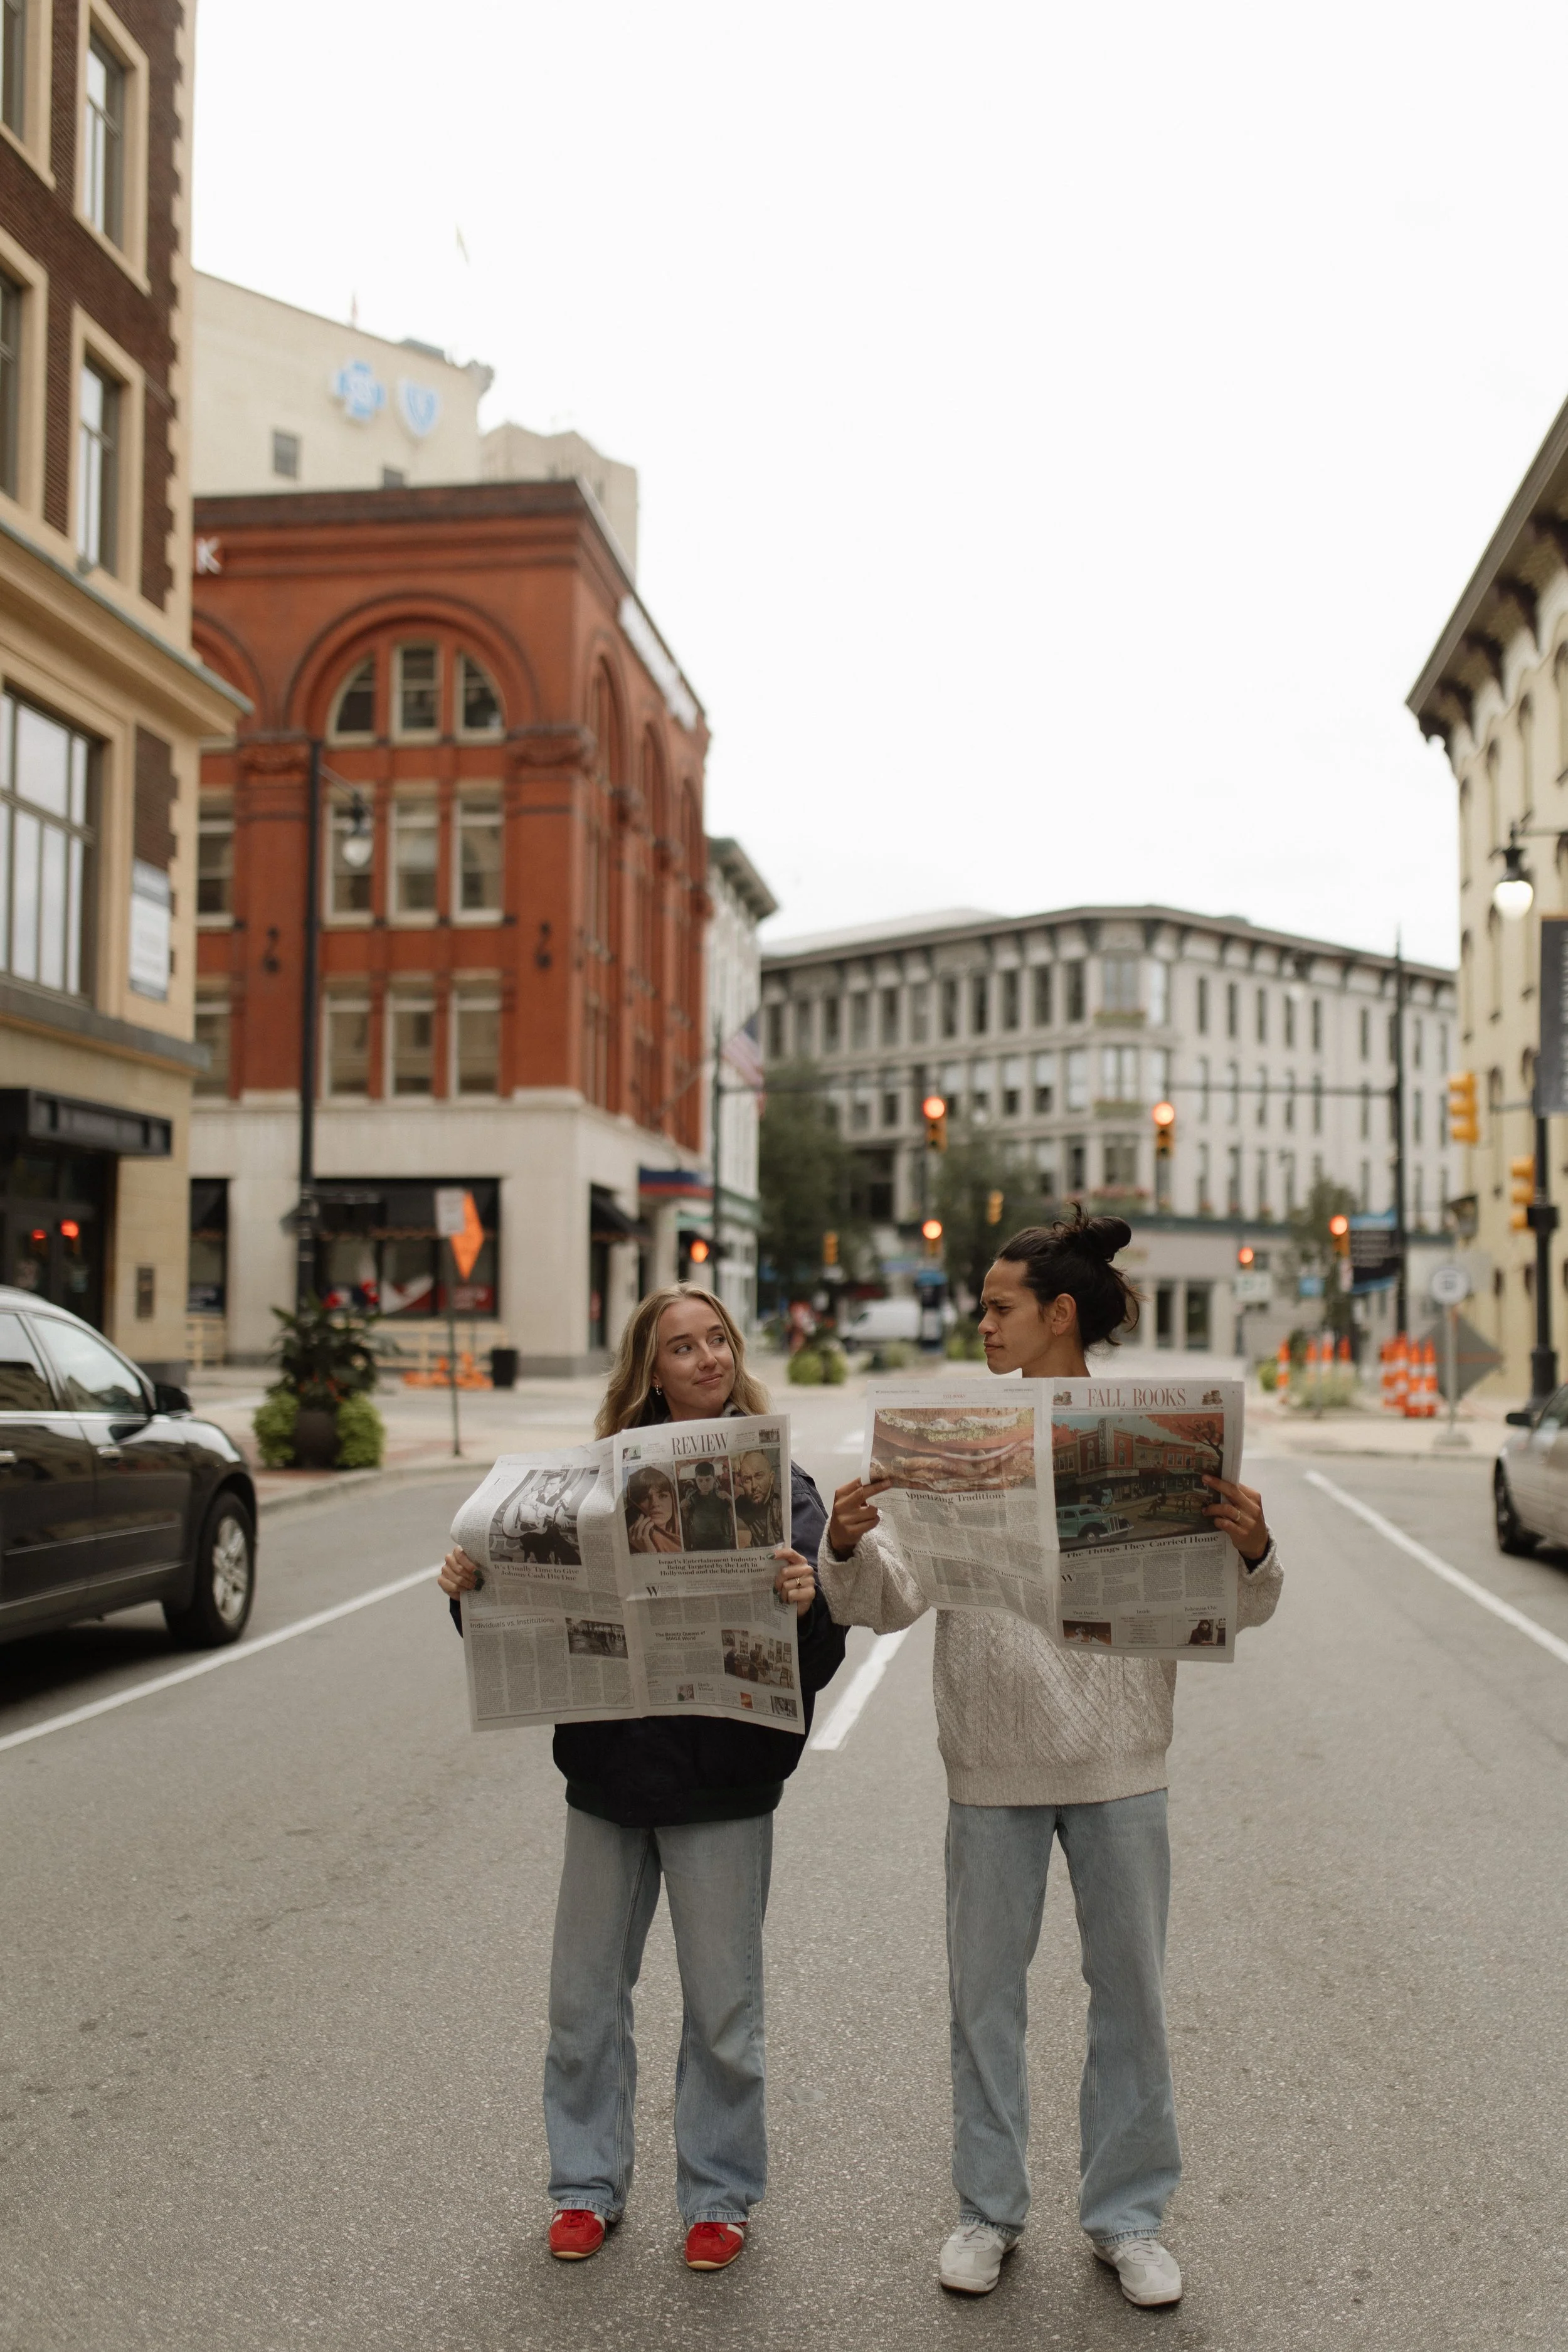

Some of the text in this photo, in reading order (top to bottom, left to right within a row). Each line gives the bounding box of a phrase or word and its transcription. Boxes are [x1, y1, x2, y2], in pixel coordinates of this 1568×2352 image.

[1088, 1388, 1187, 1407] FALL BOOKS
[672, 1433, 729, 1455] REVIEW
[906, 1491, 1006, 1505] Appetizing Traditions
[929, 1550, 953, 1559] Visions
[1086, 1546, 1120, 1555] Things
[1150, 1539, 1187, 1547] Carried
[507, 1564, 531, 1572] Finally
